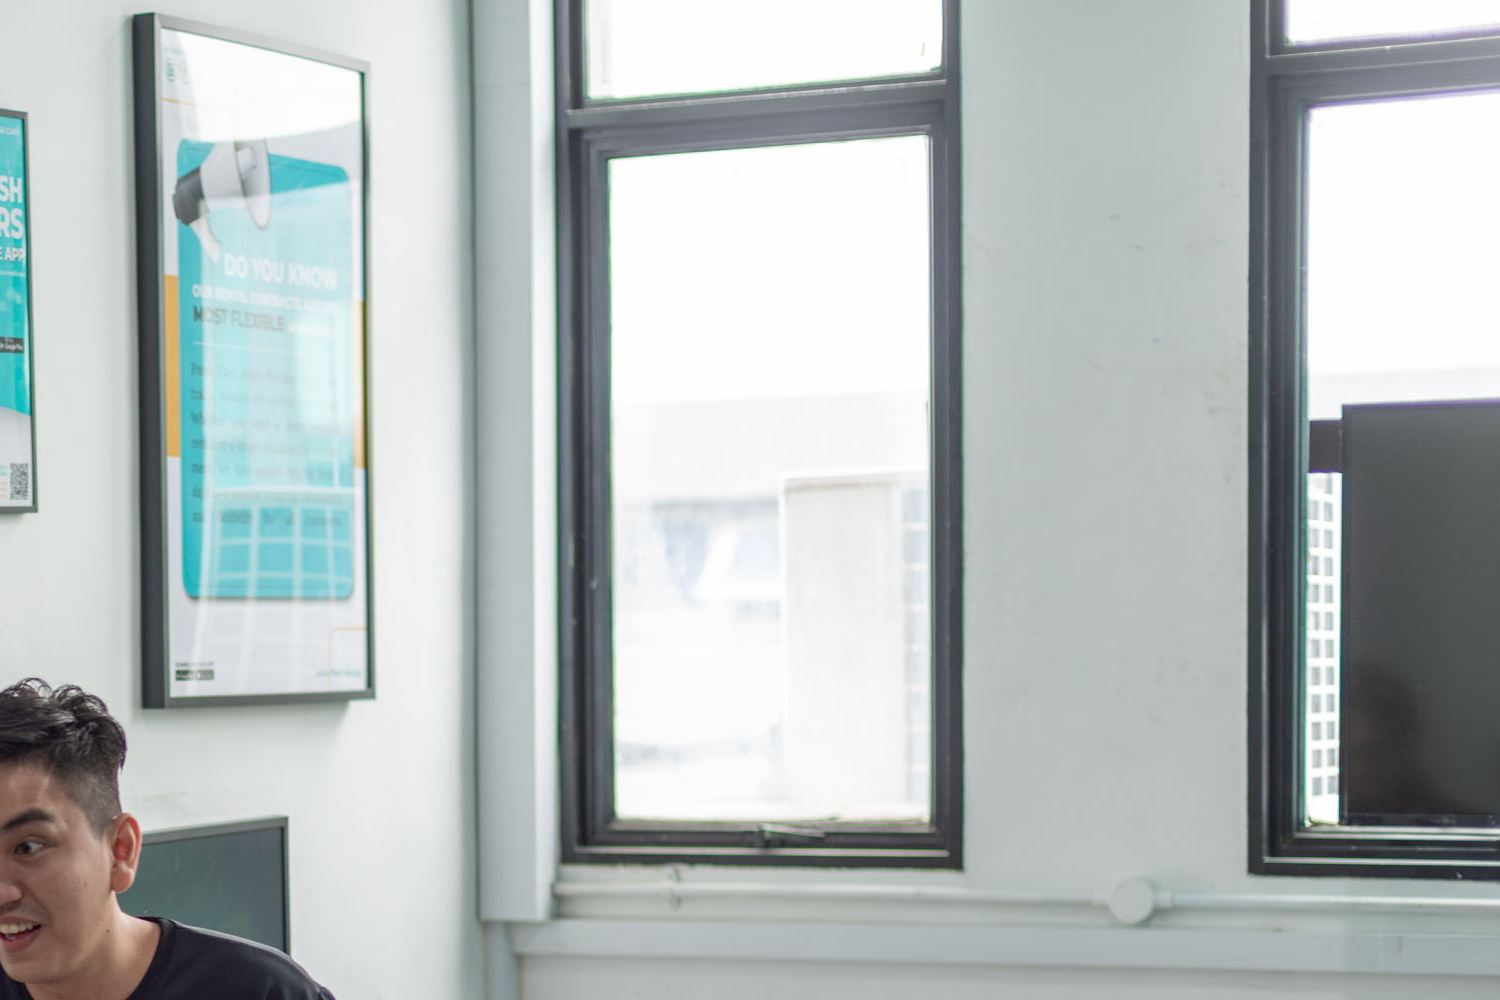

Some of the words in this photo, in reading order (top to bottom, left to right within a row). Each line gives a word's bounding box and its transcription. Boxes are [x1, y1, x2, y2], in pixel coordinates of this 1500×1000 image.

[4, 246, 26, 262] APP
[223, 253, 248, 279] DO
[251, 257, 286, 284] YOU
[287, 262, 339, 291] KNOW
[191, 283, 214, 300] OUR
[214, 286, 250, 304] RENTAL
[250, 292, 301, 312] CONTRACTS
[192, 304, 229, 326] MOST
[230, 309, 286, 333] FLEXIBLE
